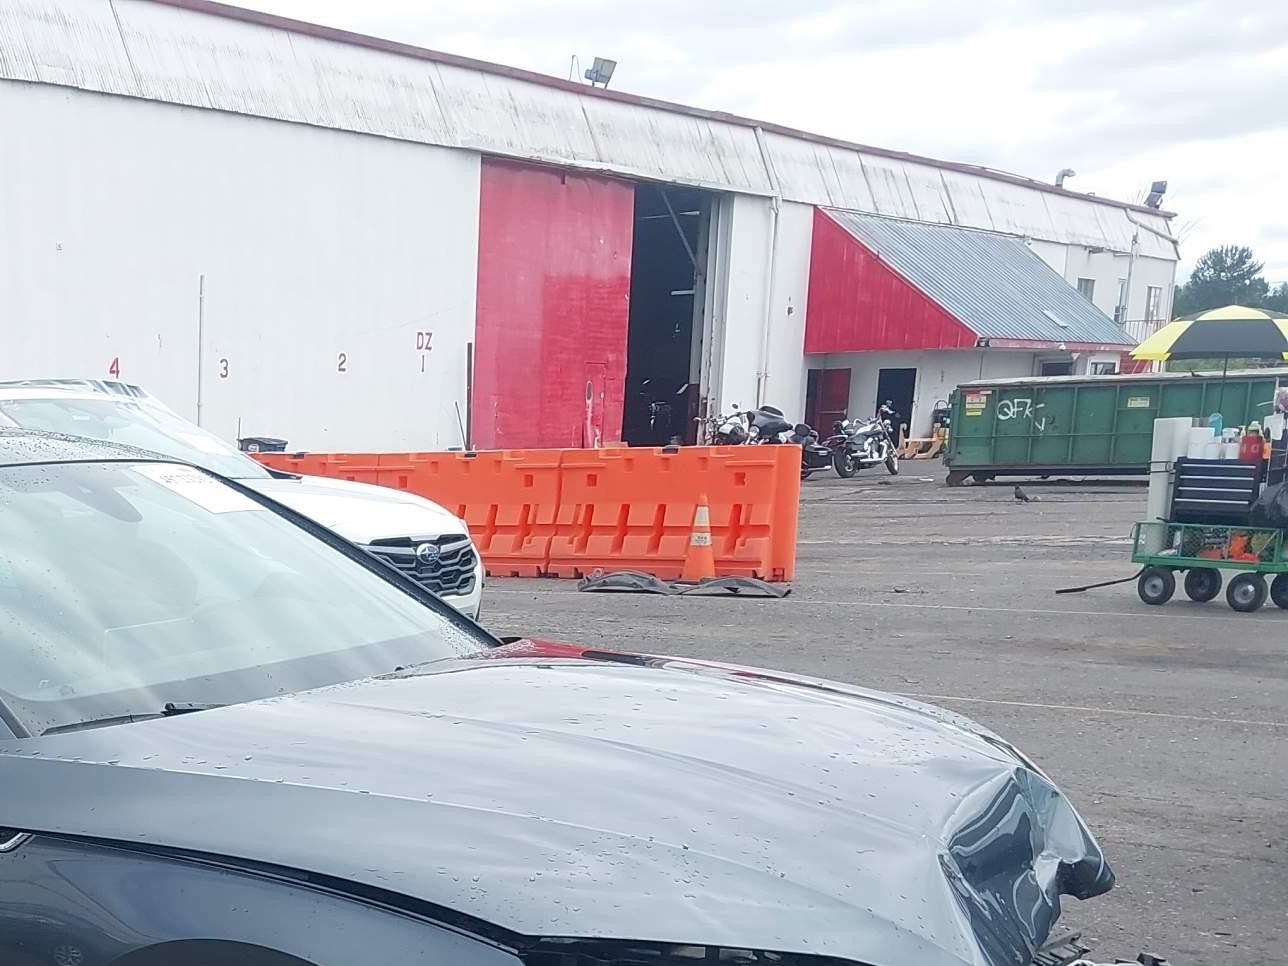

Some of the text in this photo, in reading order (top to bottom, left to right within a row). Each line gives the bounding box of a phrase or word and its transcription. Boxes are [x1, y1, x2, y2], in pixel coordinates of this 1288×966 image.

[416, 331, 433, 351] DZ
[109, 357, 120, 379] 4
[219, 358, 229, 378] 3
[338, 353, 347, 372] 2
